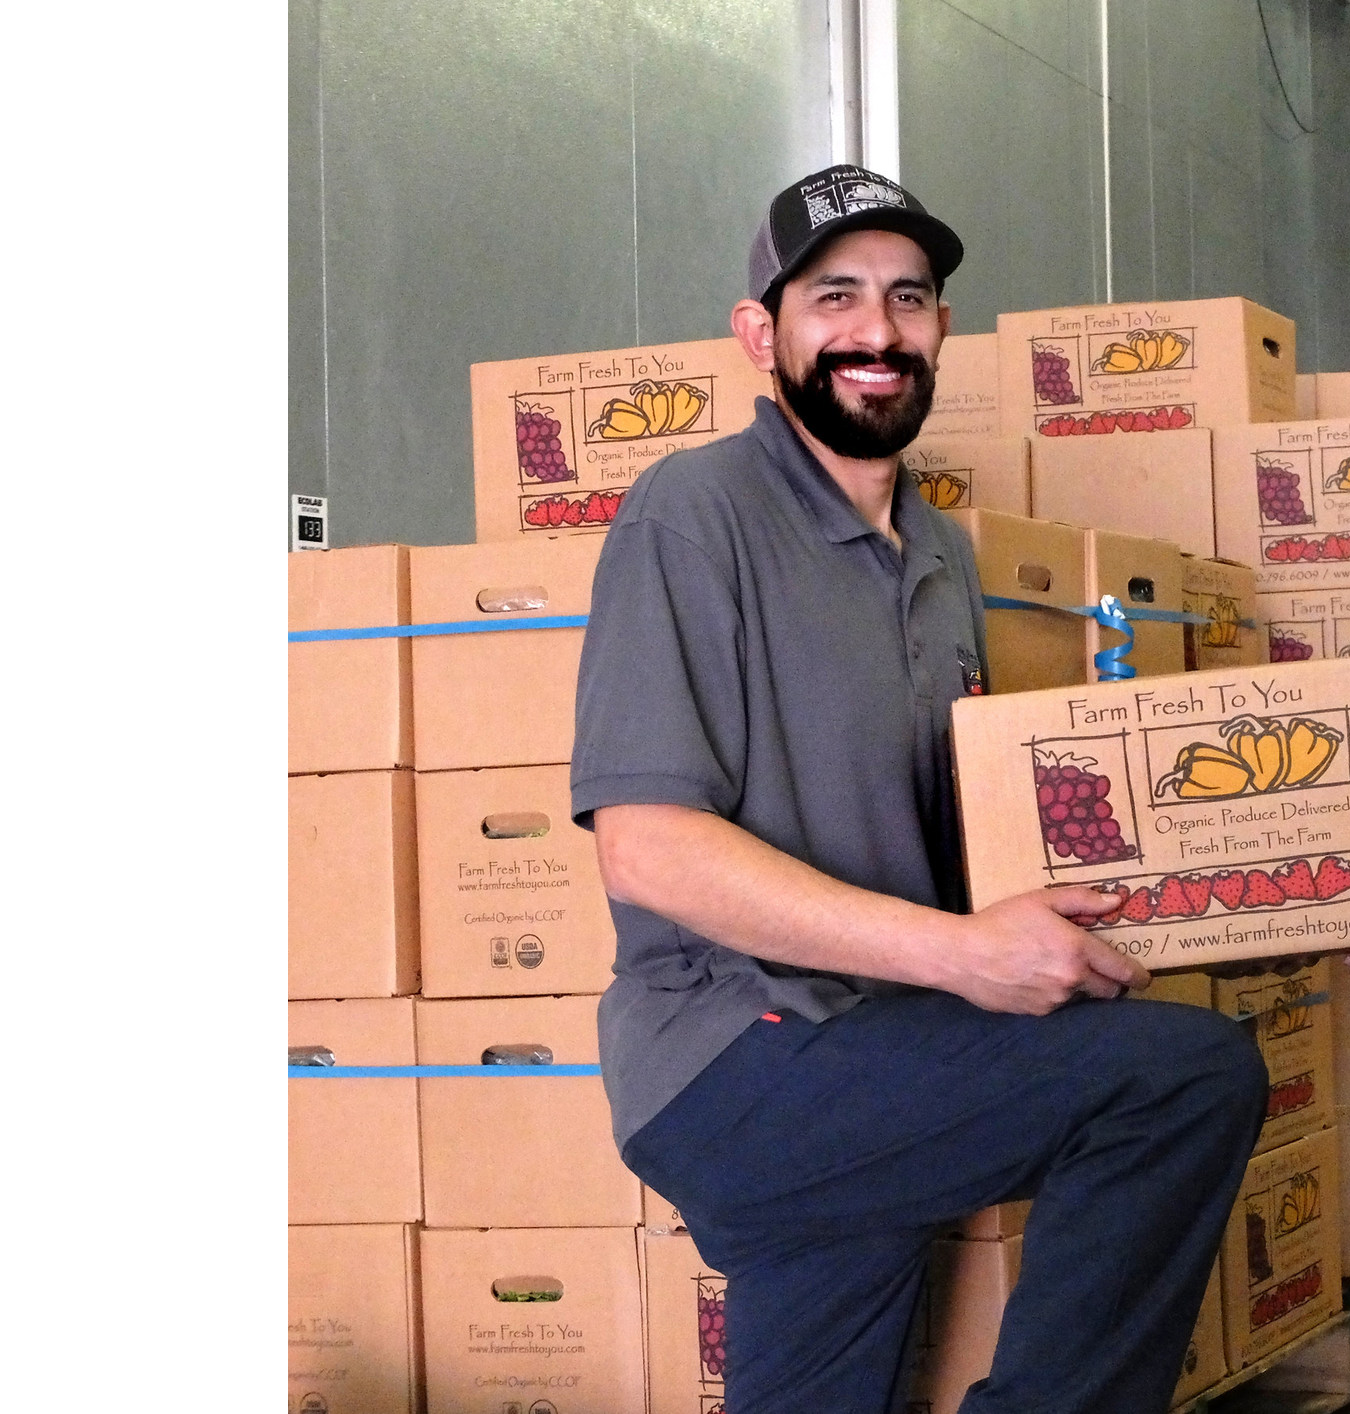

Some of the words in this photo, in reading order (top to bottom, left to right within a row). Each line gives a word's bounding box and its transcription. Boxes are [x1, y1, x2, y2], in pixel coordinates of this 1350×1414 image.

[800, 179, 826, 196] Farm
[831, 168, 864, 183] Fresh
[868, 172, 880, 181] To
[1051, 317, 1082, 334] Farm
[1084, 314, 1121, 331] Fresh
[1122, 312, 1142, 329] To
[1145, 310, 1171, 327] You
[538, 365, 574, 387] Farm
[578, 358, 622, 384] Fresh
[624, 357, 648, 378] To
[651, 353, 684, 376] You
[1090, 379, 1121, 392] Organic
[1123, 377, 1153, 390] Produce
[1155, 375, 1192, 388] Delivered
[936, 394, 960, 406] Fresh
[962, 393, 975, 404] To
[977, 393, 995, 403] You
[1102, 393, 1121, 404] Fresh
[1124, 392, 1143, 404] From
[1146, 391, 1160, 402] The
[1162, 390, 1181, 400] Farm
[1278, 427, 1313, 446] Farm
[586, 449, 624, 464] Organic
[628, 446, 664, 460] Produce
[919, 449, 947, 468] You
[601, 468, 626, 481] Fresh
[629, 466, 644, 479] Fro
[1291, 598, 1326, 618] Farm
[1067, 698, 1128, 729] Farm
[1134, 687, 1204, 722] Fresh
[1208, 683, 1246, 714] To
[1251, 679, 1303, 710] You
[1155, 815, 1216, 835] Organic
[1221, 806, 1278, 827] Produce
[1281, 796, 1350, 821] Delivered
[1179, 838, 1219, 859] Fresh
[1223, 835, 1260, 854] From
[1261, 830, 1295, 849] The
[1297, 827, 1332, 846] Farm
[458, 862, 485, 879] Farm
[488, 860, 521, 877] Fresh
[522, 859, 541, 875] To
[543, 858, 568, 875] You
[457, 877, 570, 893] www.farmfreshtoyou.com
[464, 912, 495, 925] Certified
[496, 912, 524, 924] Organic
[525, 911, 534, 923] by
[535, 909, 566, 922] CCOF
[521, 943, 538, 951] USDA
[1161, 933, 1170, 954] /
[327, 1318, 352, 1334] You
[468, 1324, 496, 1340] Farm
[500, 1324, 534, 1340] Fresh
[536, 1324, 554, 1340] To
[557, 1324, 583, 1340] You
[468, 1341, 586, 1358] www.farmfreshtoyou.com
